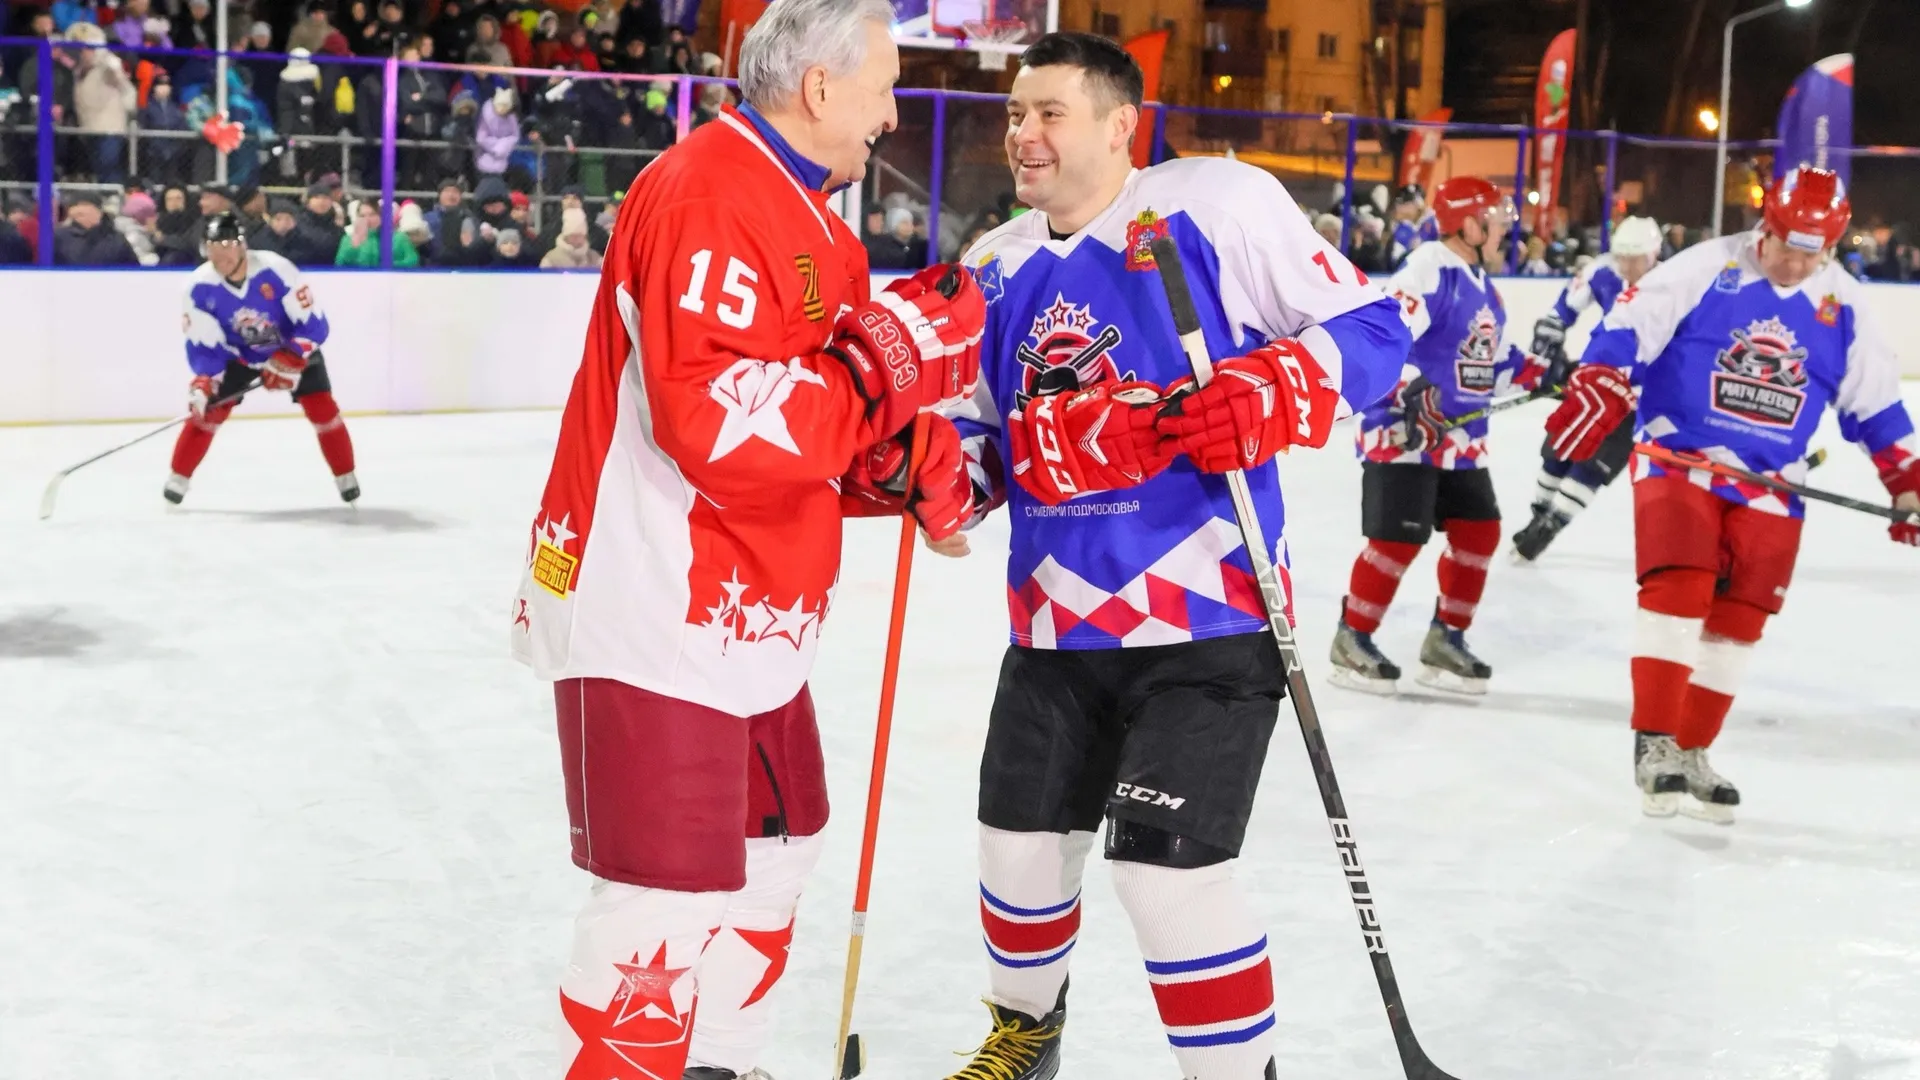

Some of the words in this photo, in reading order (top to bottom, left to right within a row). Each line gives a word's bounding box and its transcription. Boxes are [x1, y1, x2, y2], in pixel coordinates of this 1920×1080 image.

[678, 248, 759, 330] 15
[859, 311, 918, 392] СССР
[1036, 395, 1078, 494] CCM
[1025, 506, 1032, 517] С
[1067, 500, 1140, 517] ПОДМОСКОВЬЯ
[1115, 782, 1186, 810] CCM
